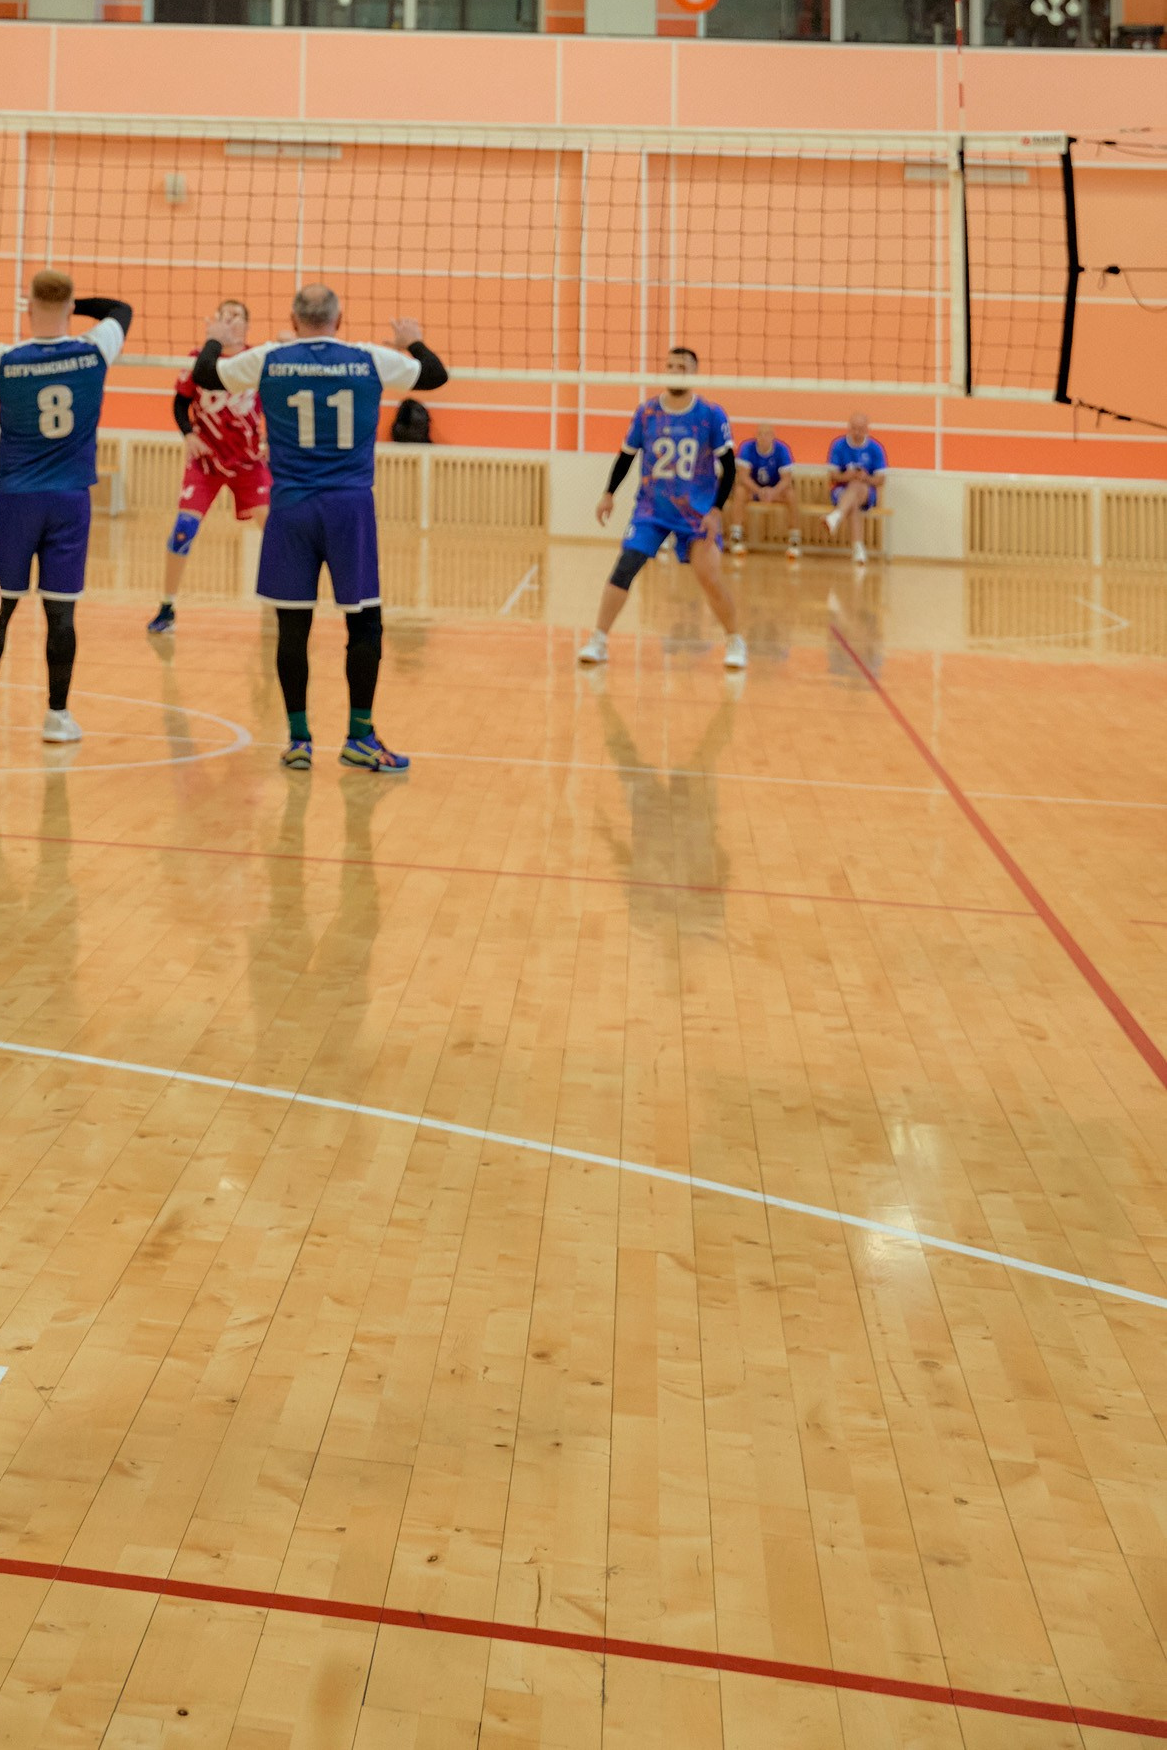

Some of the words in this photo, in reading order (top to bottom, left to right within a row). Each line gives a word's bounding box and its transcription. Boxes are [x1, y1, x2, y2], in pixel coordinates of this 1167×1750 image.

[37, 383, 75, 440] 8
[286, 389, 354, 450] 11
[651, 437, 699, 481] 28
